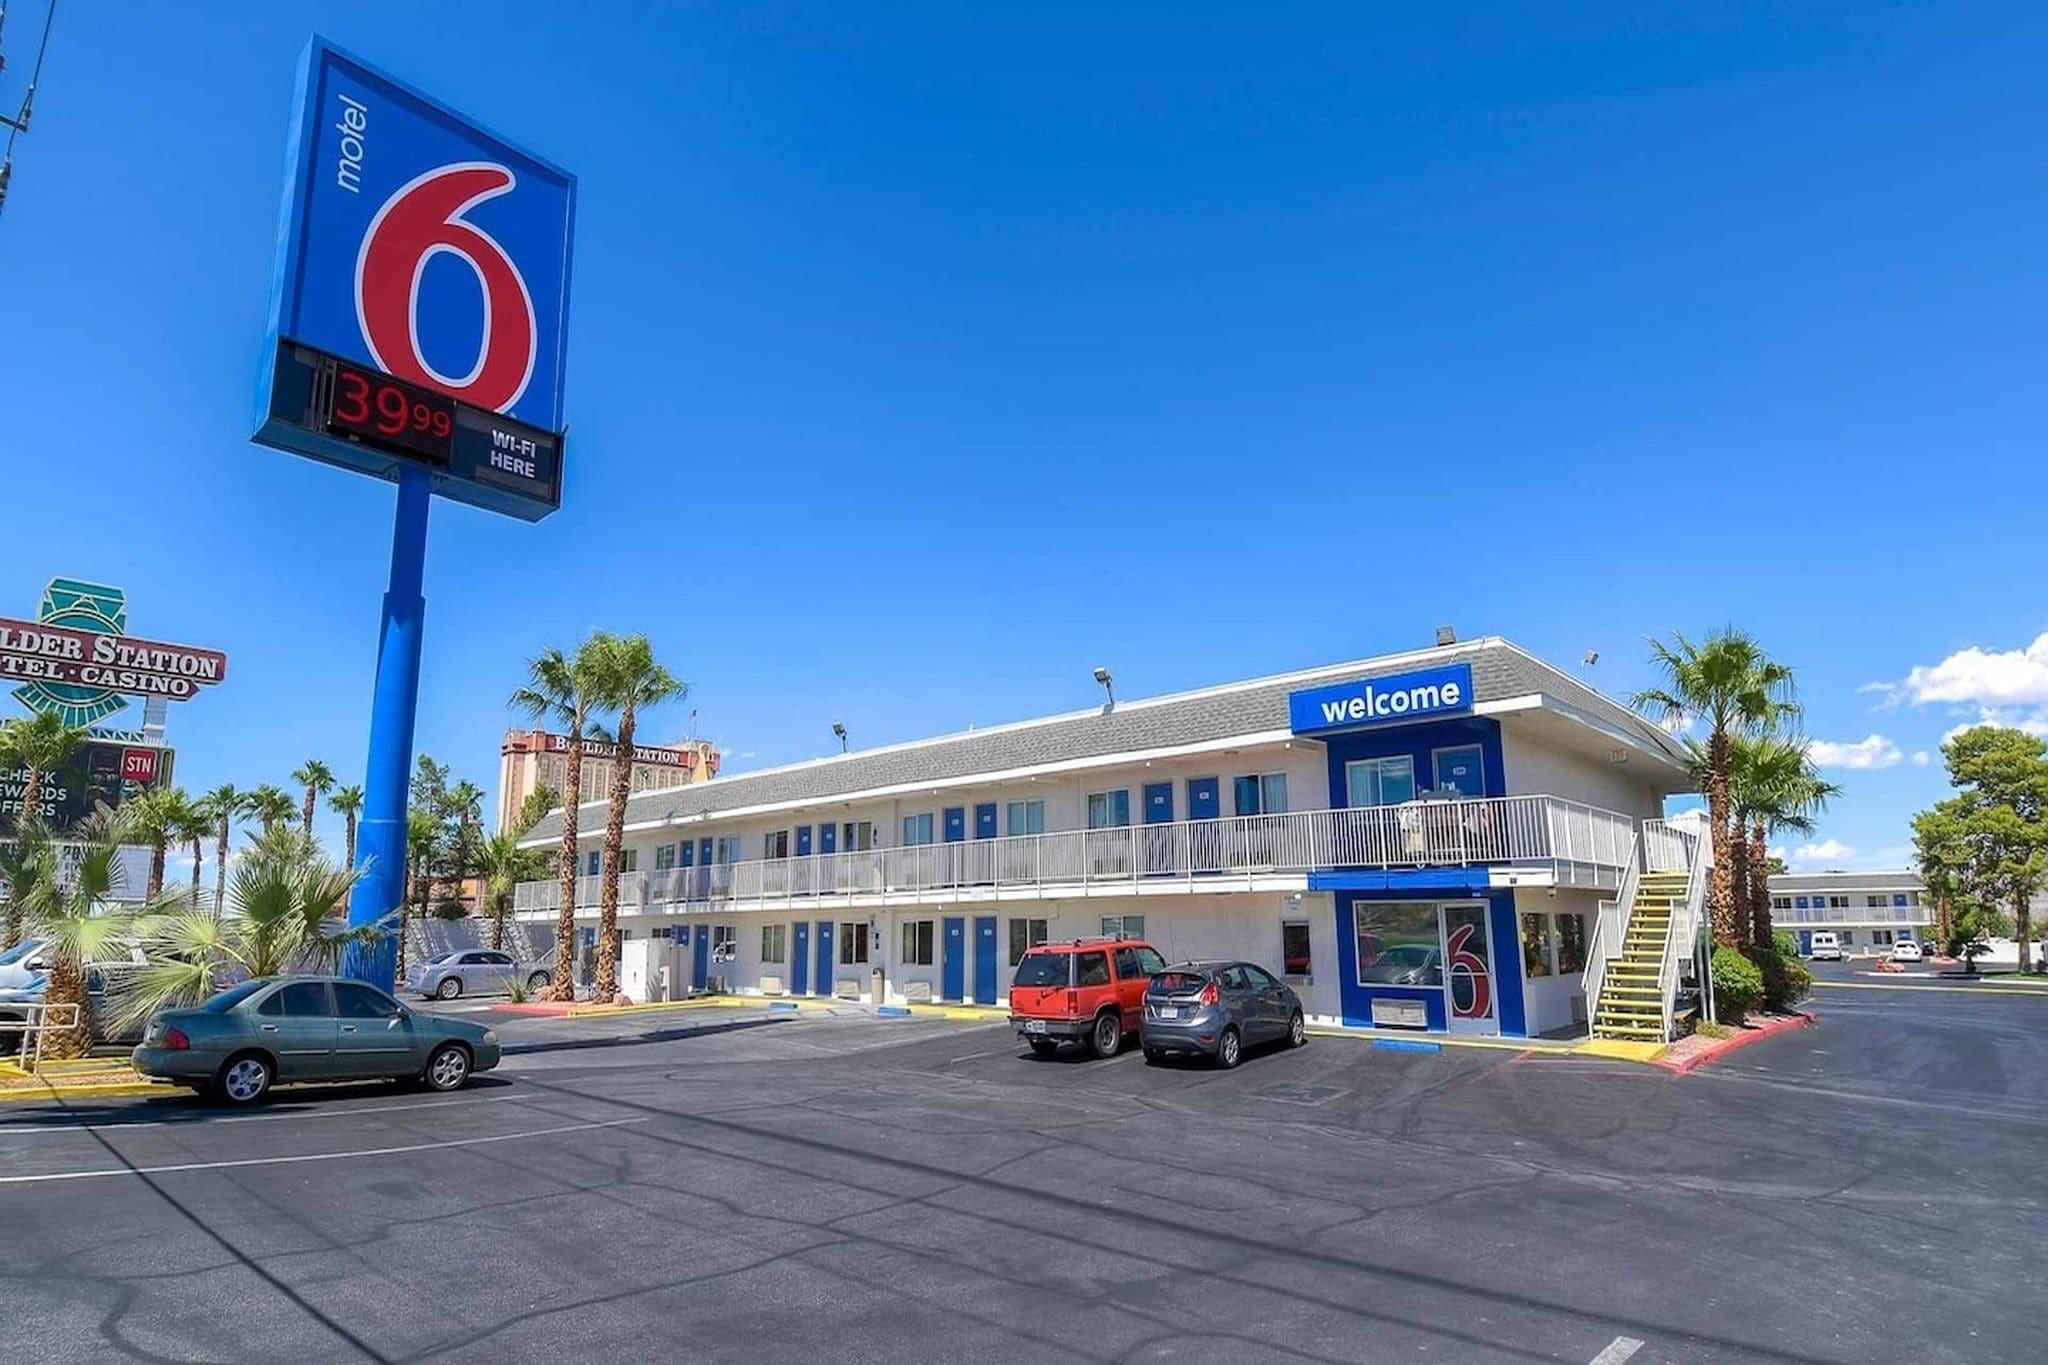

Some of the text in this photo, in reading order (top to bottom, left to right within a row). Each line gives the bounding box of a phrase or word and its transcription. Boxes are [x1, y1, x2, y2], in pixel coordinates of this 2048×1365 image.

[336, 94, 368, 193] motel
[354, 161, 537, 415] 6
[491, 429, 536, 458] WI-FI
[489, 450, 536, 479] HERE
[0, 627, 219, 678] LDER STATION
[0, 655, 190, 695] TEL CASINO
[1321, 682, 1460, 723] welcome
[126, 756, 152, 773] STN
[0, 800, 56, 816] FFRS
[1447, 923, 1493, 1019] 6
